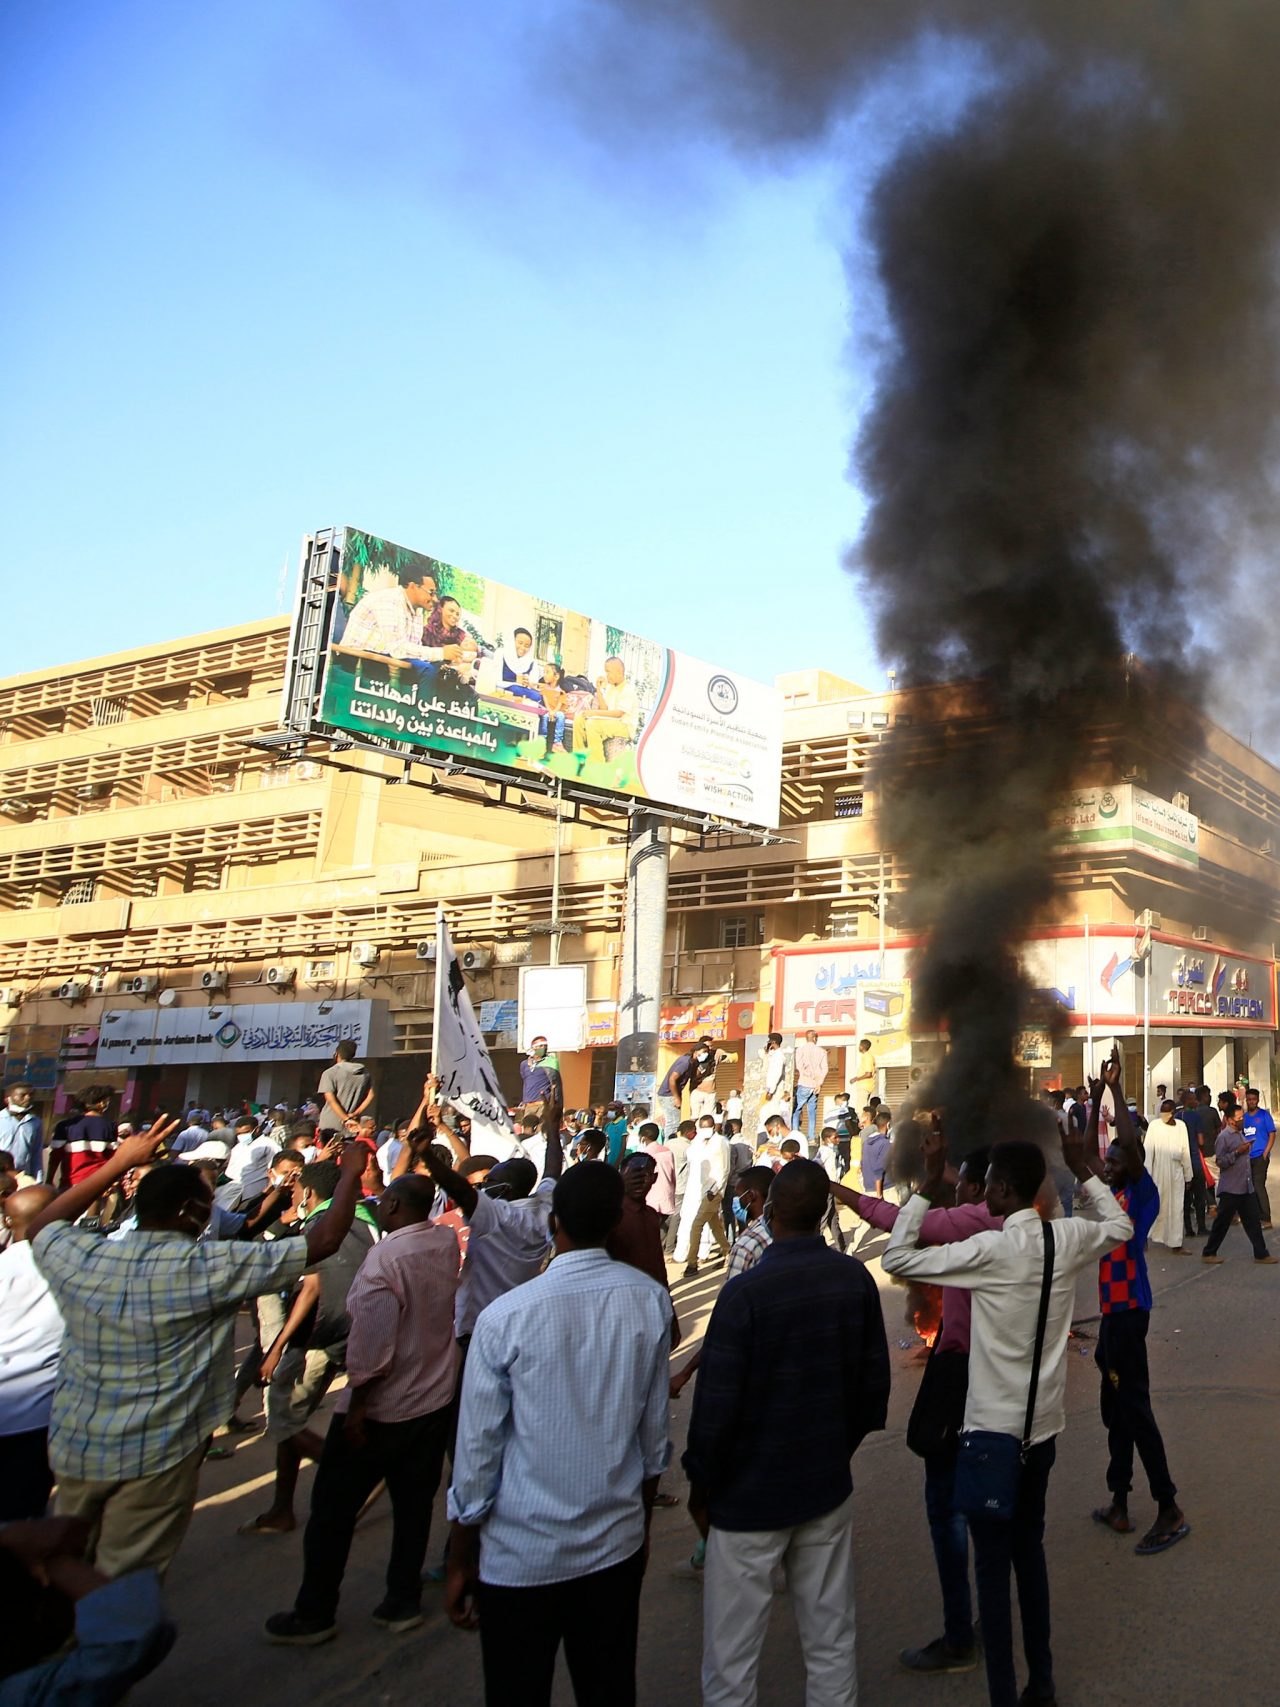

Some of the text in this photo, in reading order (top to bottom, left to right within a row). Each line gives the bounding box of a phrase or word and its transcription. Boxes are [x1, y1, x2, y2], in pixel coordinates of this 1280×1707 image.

[354, 676, 419, 706] أمهاتنا
[350, 699, 498, 753] بالمباعدة بين ولاداتنا
[1165, 990, 1213, 1015] TARCO
[164, 1034, 195, 1046] Jordanian
[196, 1032, 213, 1044] Bank
